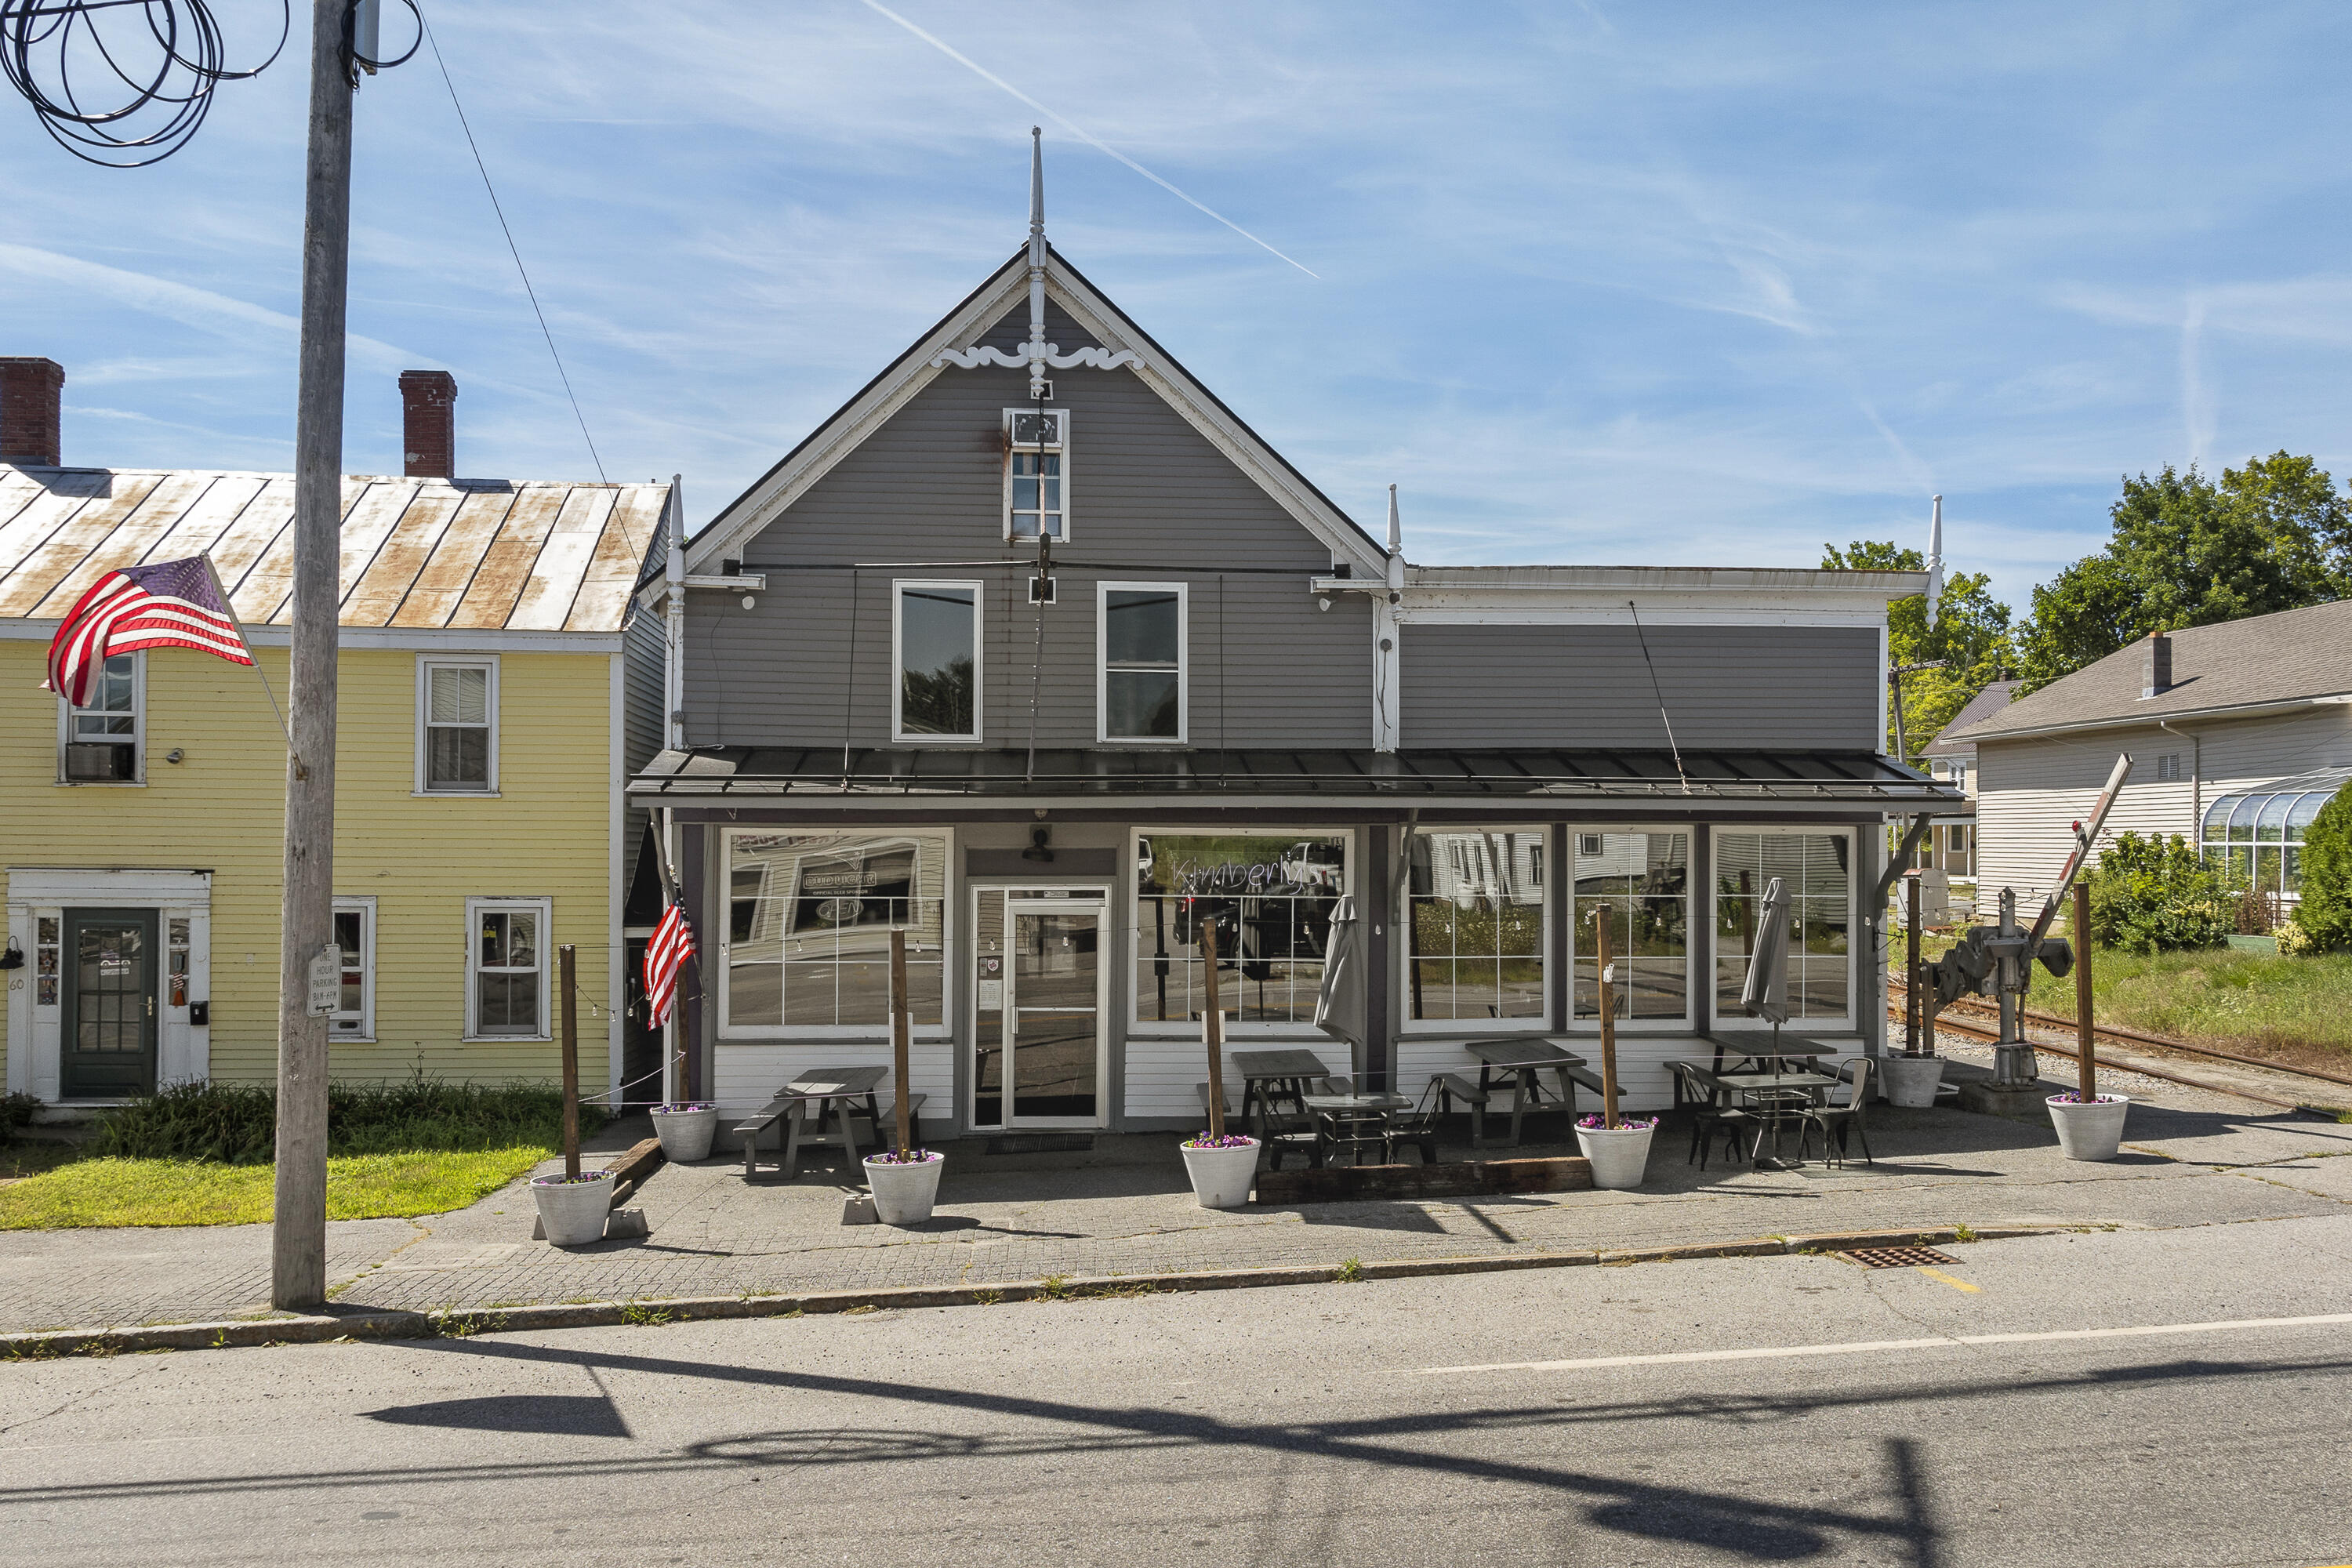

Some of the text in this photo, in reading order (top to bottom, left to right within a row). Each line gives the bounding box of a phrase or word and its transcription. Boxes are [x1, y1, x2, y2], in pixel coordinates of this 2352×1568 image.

[805, 876, 833, 886] BUD
[818, 902, 860, 916] OPEN
[320, 953, 331, 961] ONE
[317, 965, 333, 975] HOUR
[9, 978, 24, 991] 60
[313, 978, 337, 988] PARKING
